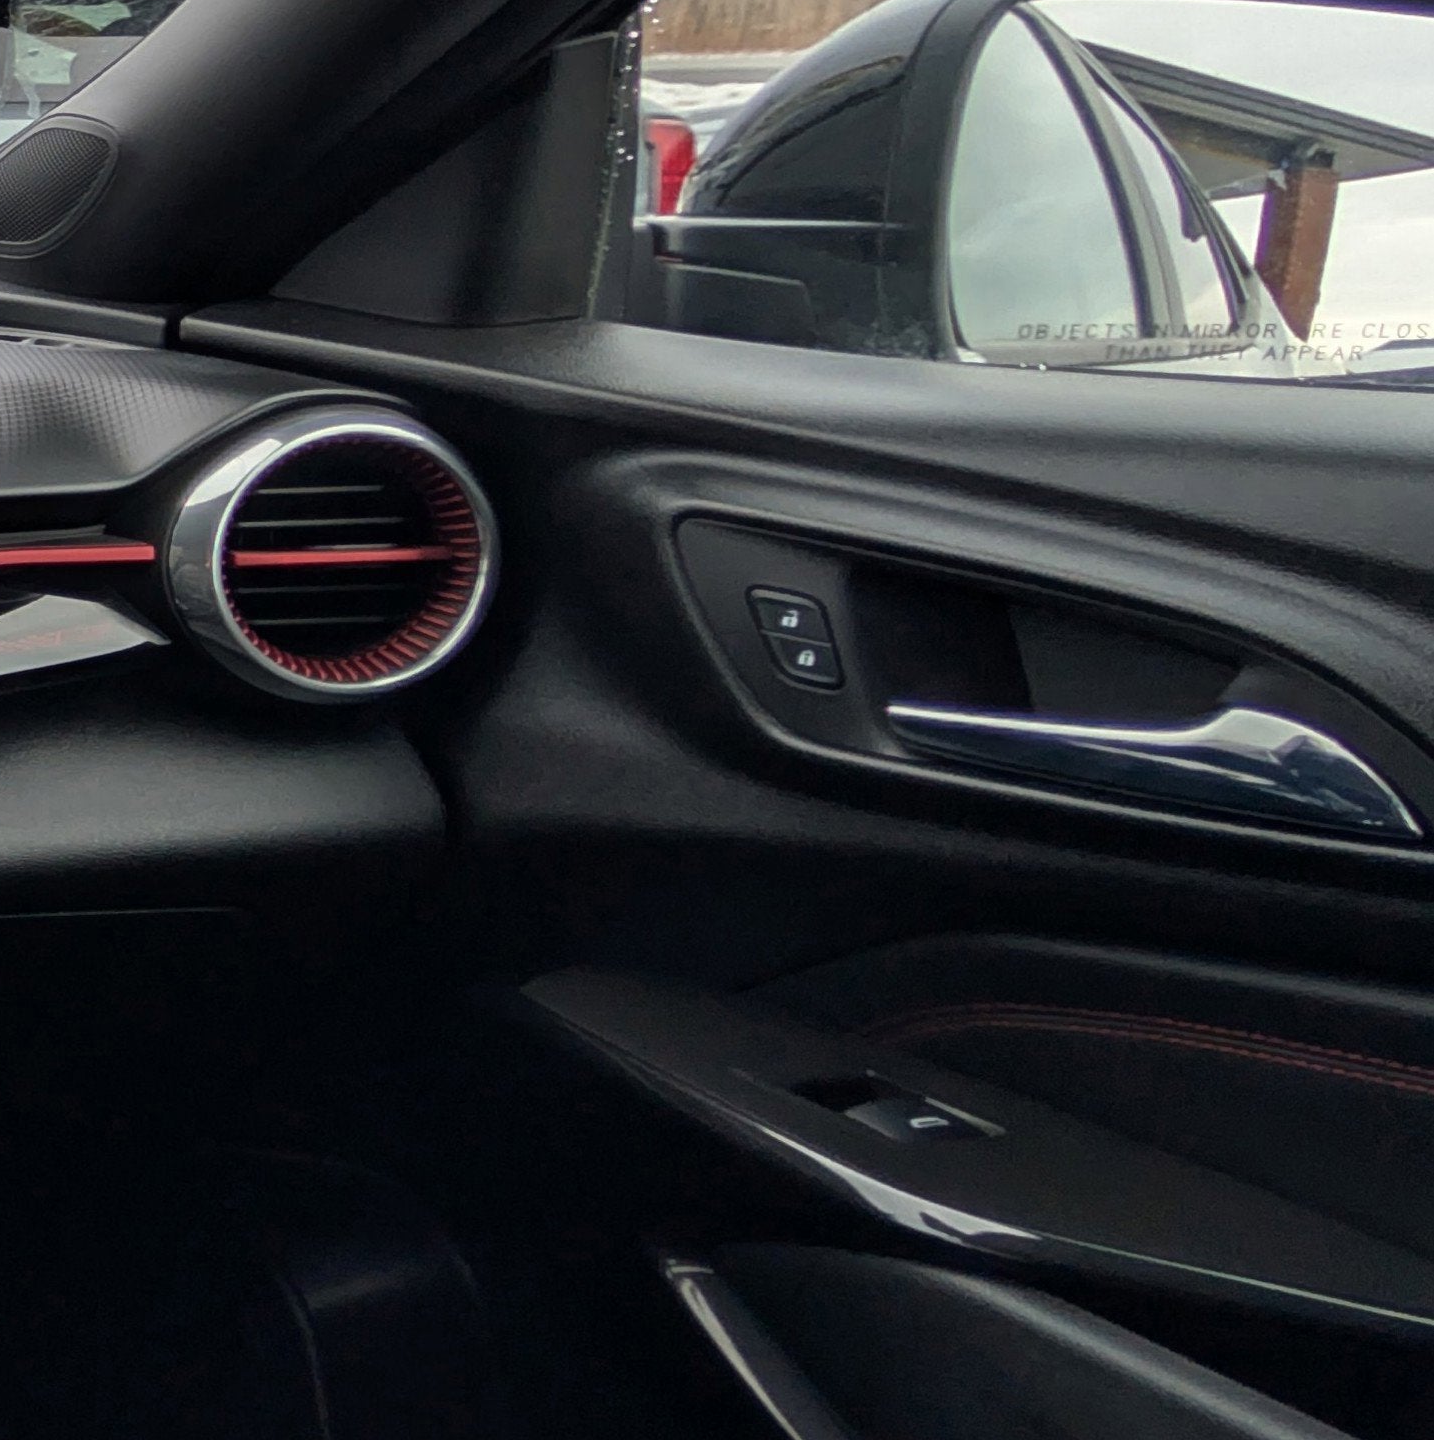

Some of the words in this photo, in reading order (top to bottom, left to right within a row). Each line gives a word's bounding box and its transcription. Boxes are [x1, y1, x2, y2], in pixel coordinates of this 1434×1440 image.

[1017, 323, 1130, 340] OBJECTS
[1180, 322, 1278, 339] MIRROR
[1262, 344, 1364, 361] APPEAR
